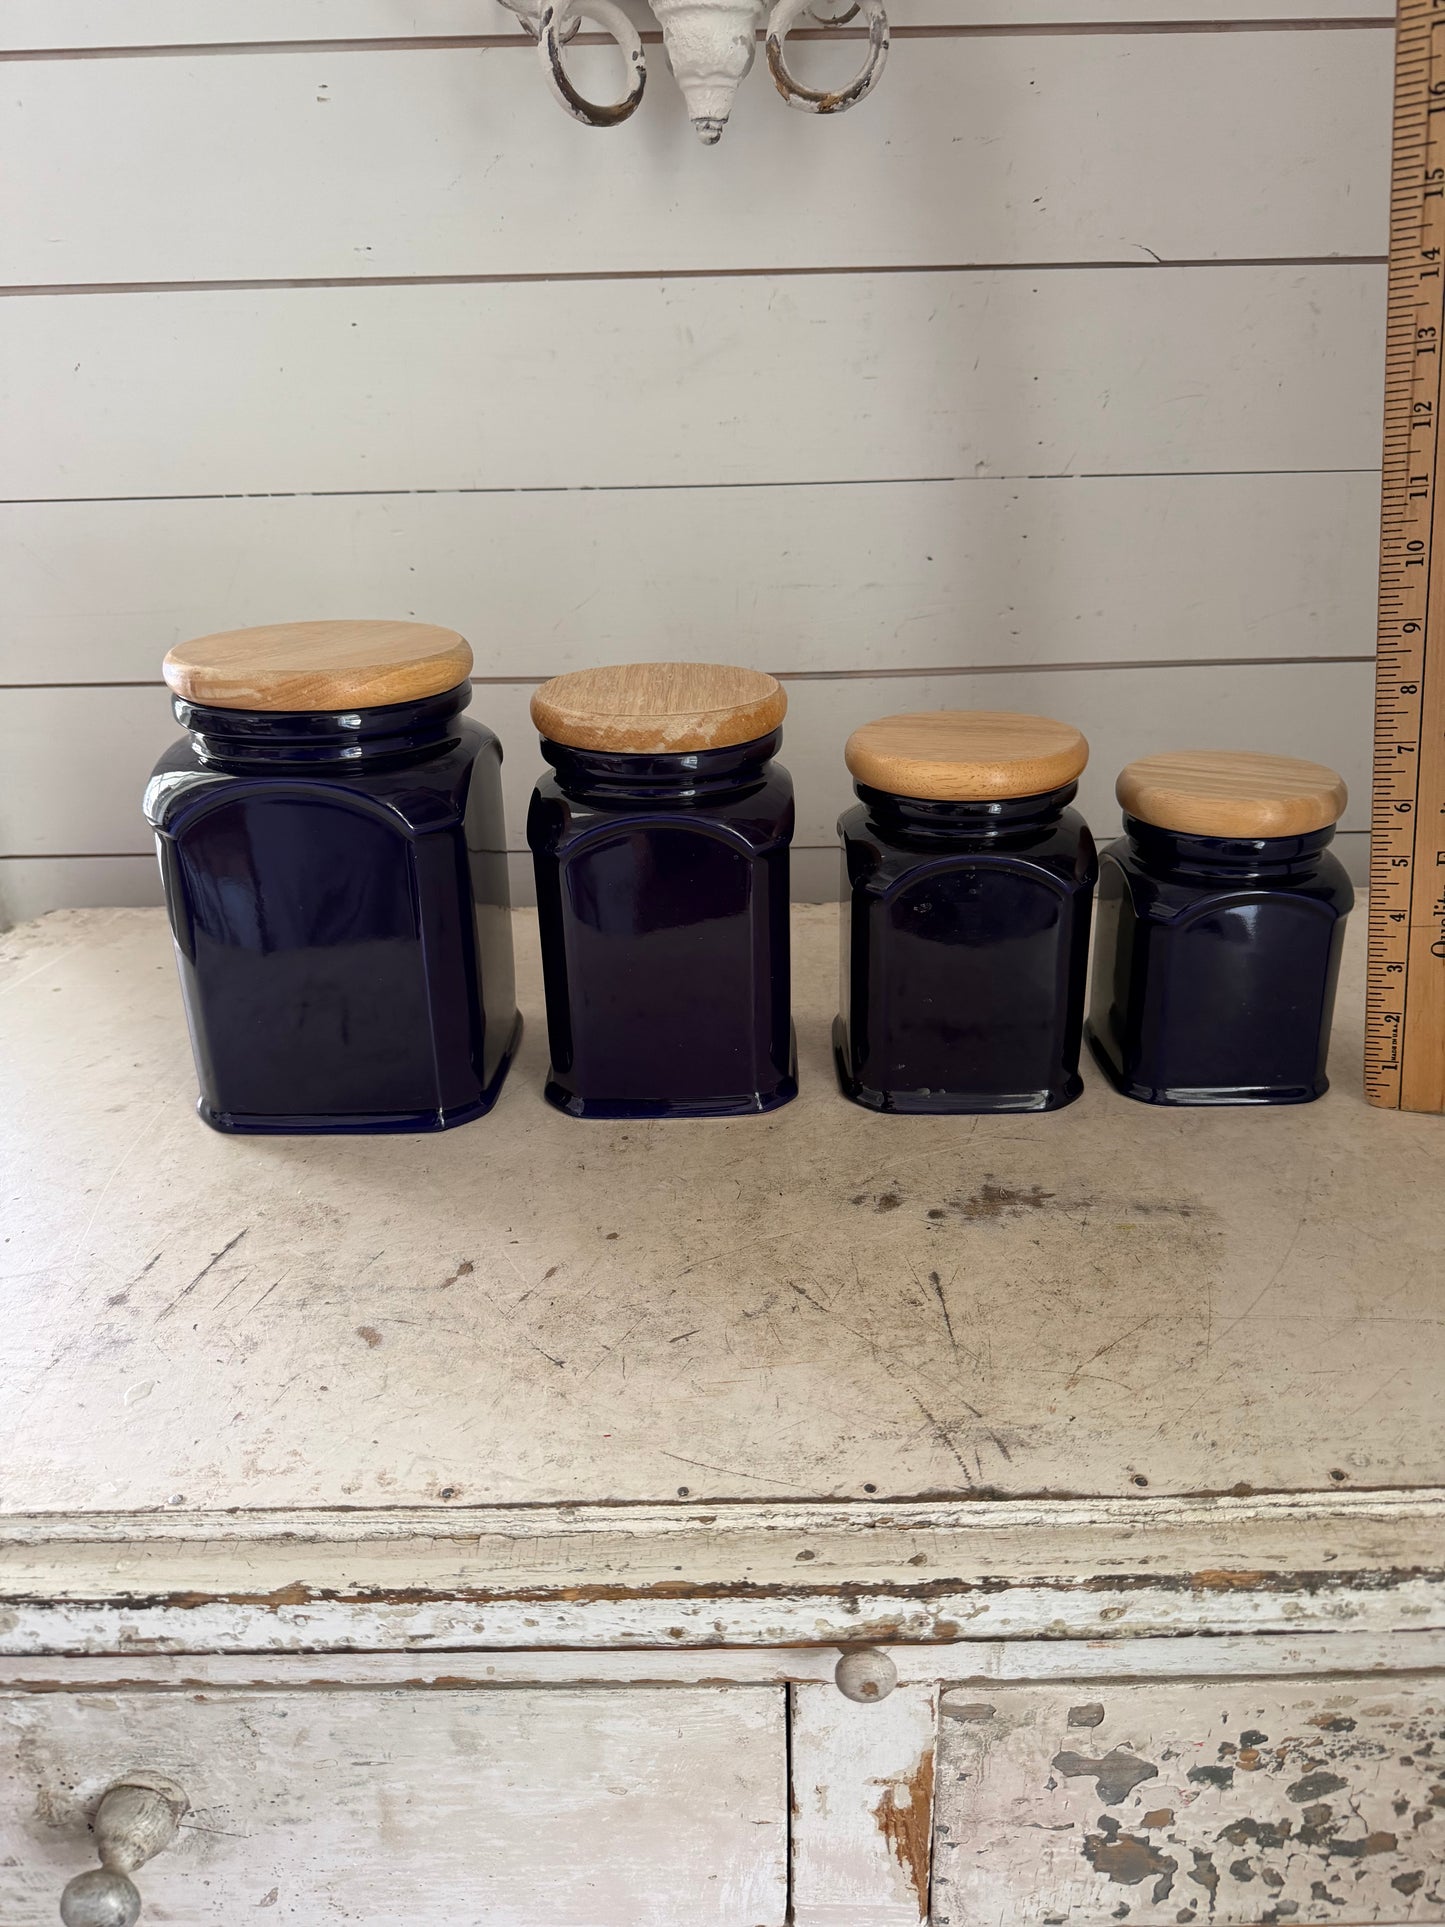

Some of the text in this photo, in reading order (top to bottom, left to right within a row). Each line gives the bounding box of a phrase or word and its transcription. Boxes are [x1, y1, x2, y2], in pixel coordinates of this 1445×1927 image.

[1428, 81, 1445, 116] 16
[1424, 168, 1444, 199] 15
[1420, 247, 1440, 280] 14
[1416, 326, 1437, 356] 13
[1412, 401, 1432, 429] 12
[1409, 473, 1429, 500] 11
[1405, 540, 1425, 567] 10
[1402, 622, 1421, 633] 9
[1400, 684, 1417, 694] 8
[1397, 745, 1415, 754] 7
[1394, 803, 1411, 813] 6
[1391, 859, 1408, 867] 5
[1389, 912, 1405, 922] 4
[1386, 965, 1403, 973] 3
[1384, 1014, 1400, 1023] 2
